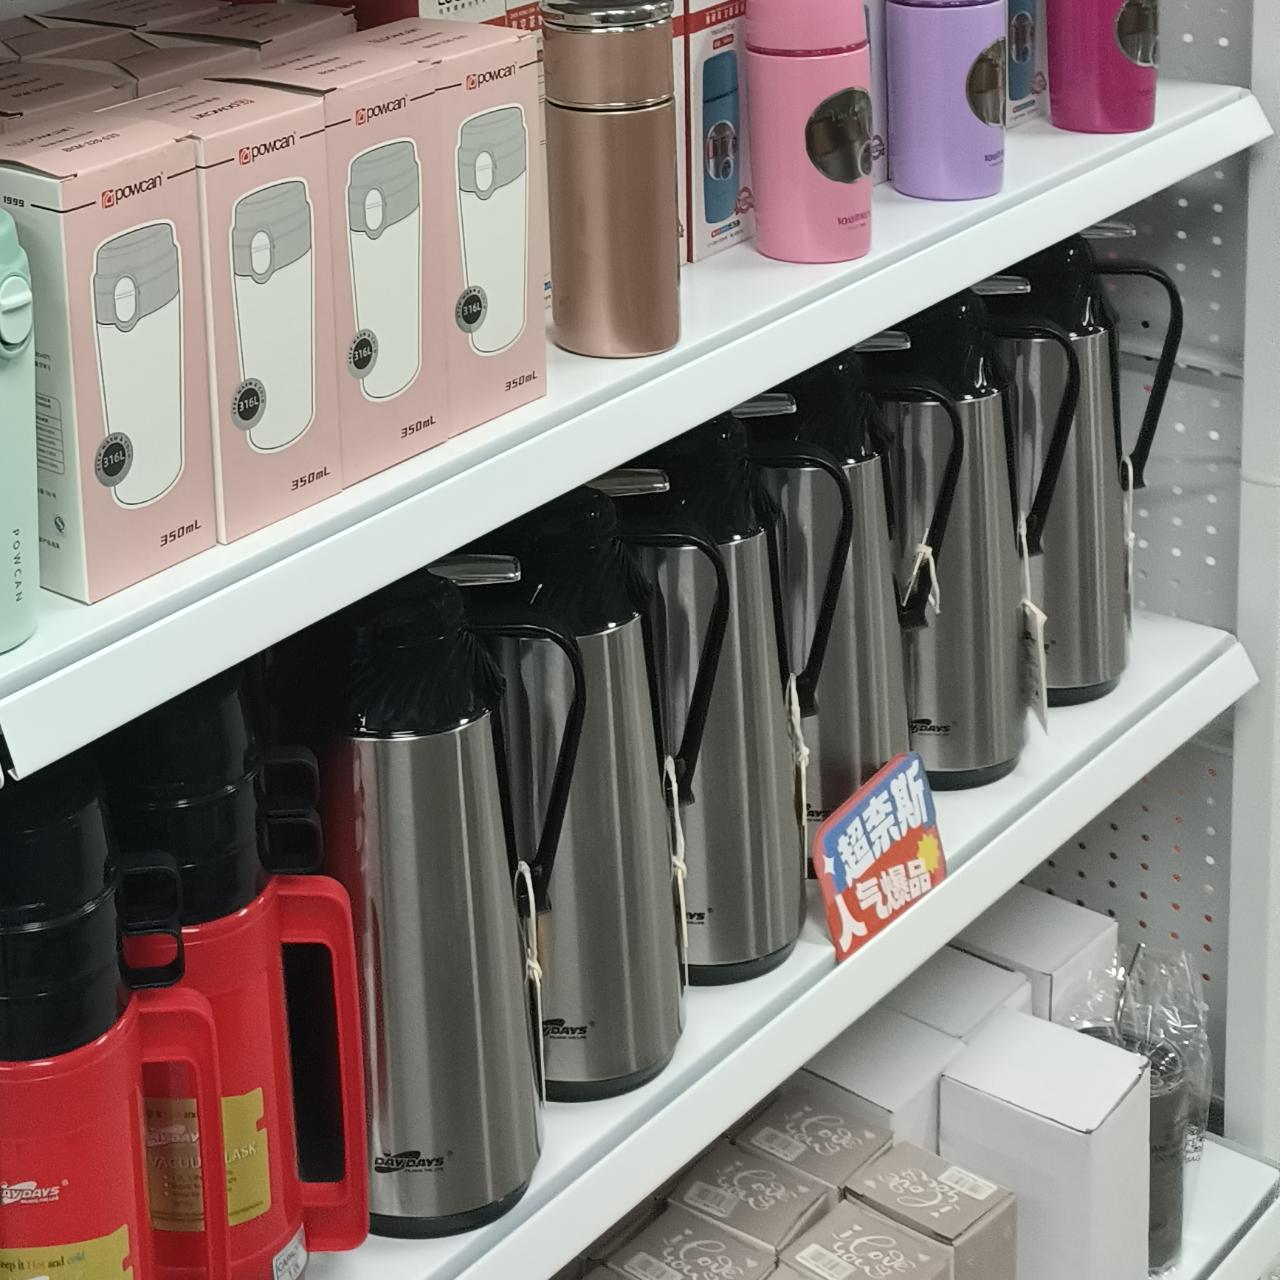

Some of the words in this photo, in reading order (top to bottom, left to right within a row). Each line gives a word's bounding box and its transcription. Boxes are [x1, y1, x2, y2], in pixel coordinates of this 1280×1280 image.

[478, 63, 516, 89] powcan
[366, 95, 407, 124] powcan
[251, 134, 296, 163] powcan
[2, 193, 25, 208] 1999
[115, 173, 163, 207] powcan
[463, 301, 482, 316] 316L
[354, 345, 372, 361] 316L
[505, 370, 538, 392] 350mL
[239, 395, 260, 413] 316L
[401, 415, 437, 440] 350mL
[103, 450, 126, 469] 316L
[290, 465, 331, 492] 350mL
[160, 519, 203, 547] 350mL
[12, 528, 24, 602] POWCAN
[835, 759, 928, 888] 超奈斯
[834, 857, 932, 953] 人气爆品
[48, 1255, 65, 1269] and
